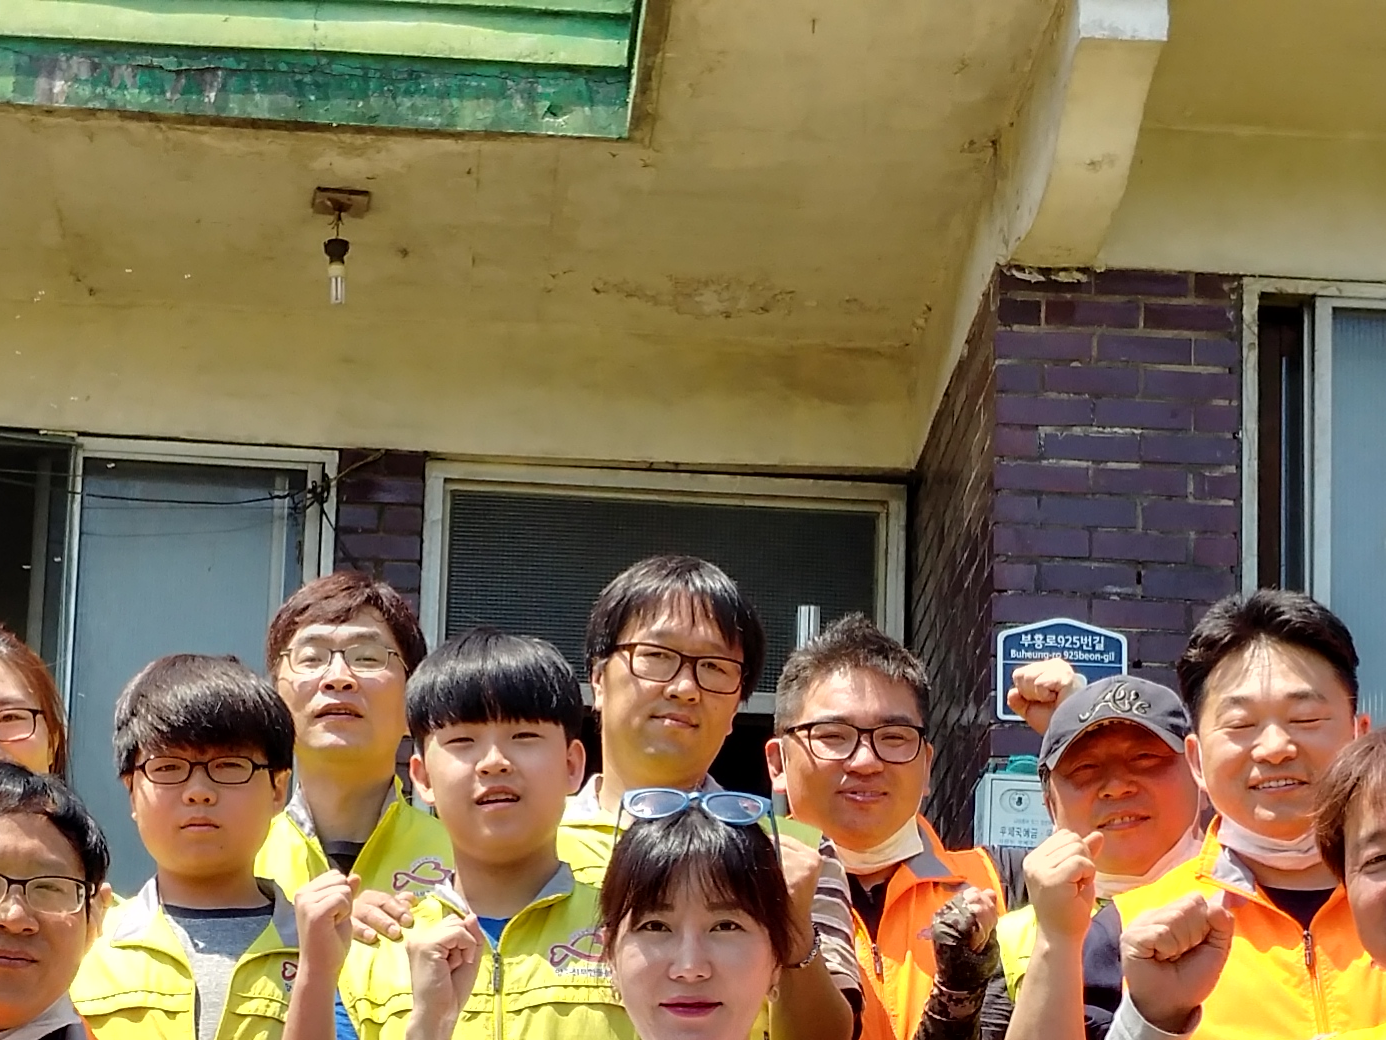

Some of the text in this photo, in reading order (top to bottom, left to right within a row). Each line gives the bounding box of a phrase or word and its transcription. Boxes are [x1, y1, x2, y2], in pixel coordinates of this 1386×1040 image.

[1019, 633, 1105, 651] 부흥로925번길
[1010, 649, 1115, 663] Buheung-ro 925beon-gil
